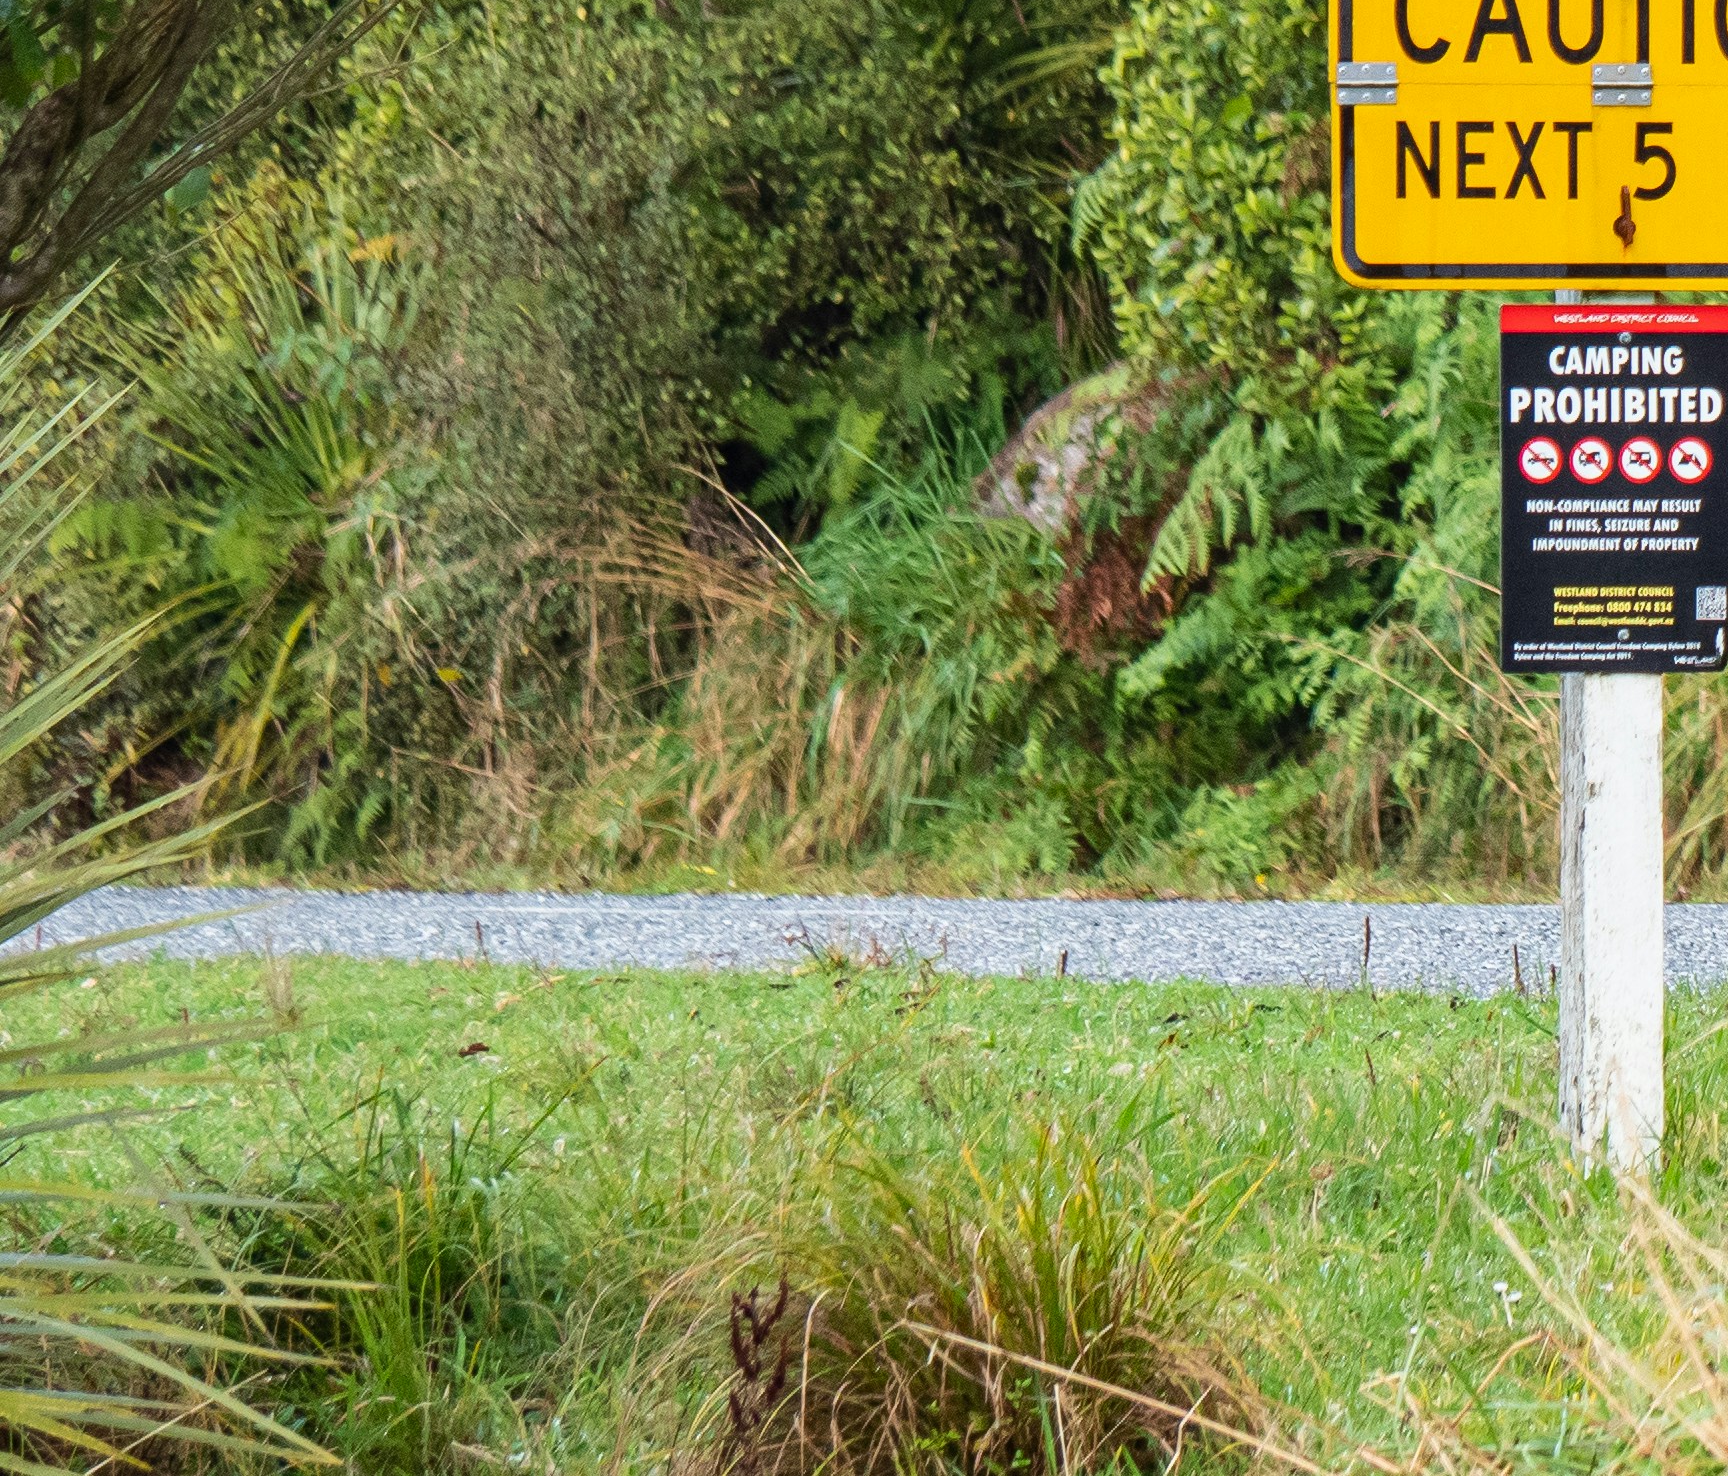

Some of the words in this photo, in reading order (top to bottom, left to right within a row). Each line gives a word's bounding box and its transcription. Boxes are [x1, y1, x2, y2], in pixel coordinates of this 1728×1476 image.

[1397, 120, 1593, 200] NEXT
[1632, 121, 1677, 202] 5
[1553, 314, 1610, 324] WESTLAND
[1610, 314, 1657, 324] DISTRICT
[1656, 314, 1700, 324] COUNCIL
[1548, 345, 1685, 375] CAMPING
[1509, 386, 1724, 424] PROHIBITED
[1526, 499, 1630, 513] NON-COMPLIANCE
[1632, 499, 1659, 513] MAY
[1661, 499, 1702, 513] RESULT
[1549, 518, 1563, 532] IN
[1565, 518, 1602, 534] FINES,
[1604, 518, 1651, 533] SEIZURE
[1653, 518, 1680, 532] AND
[1532, 537, 1621, 551] IMPOUNDMENT
[1623, 537, 1638, 551] OF
[1641, 537, 1700, 551] PROPERTY
[1553, 586, 1598, 597] WESTLAND
[1600, 586, 1637, 597] DISTRICT
[1637, 586, 1675, 597] COUNCIL
[1553, 601, 1604, 615] Freephone:
[1606, 601, 1631, 613] 0800
[1633, 601, 1652, 613] 474
